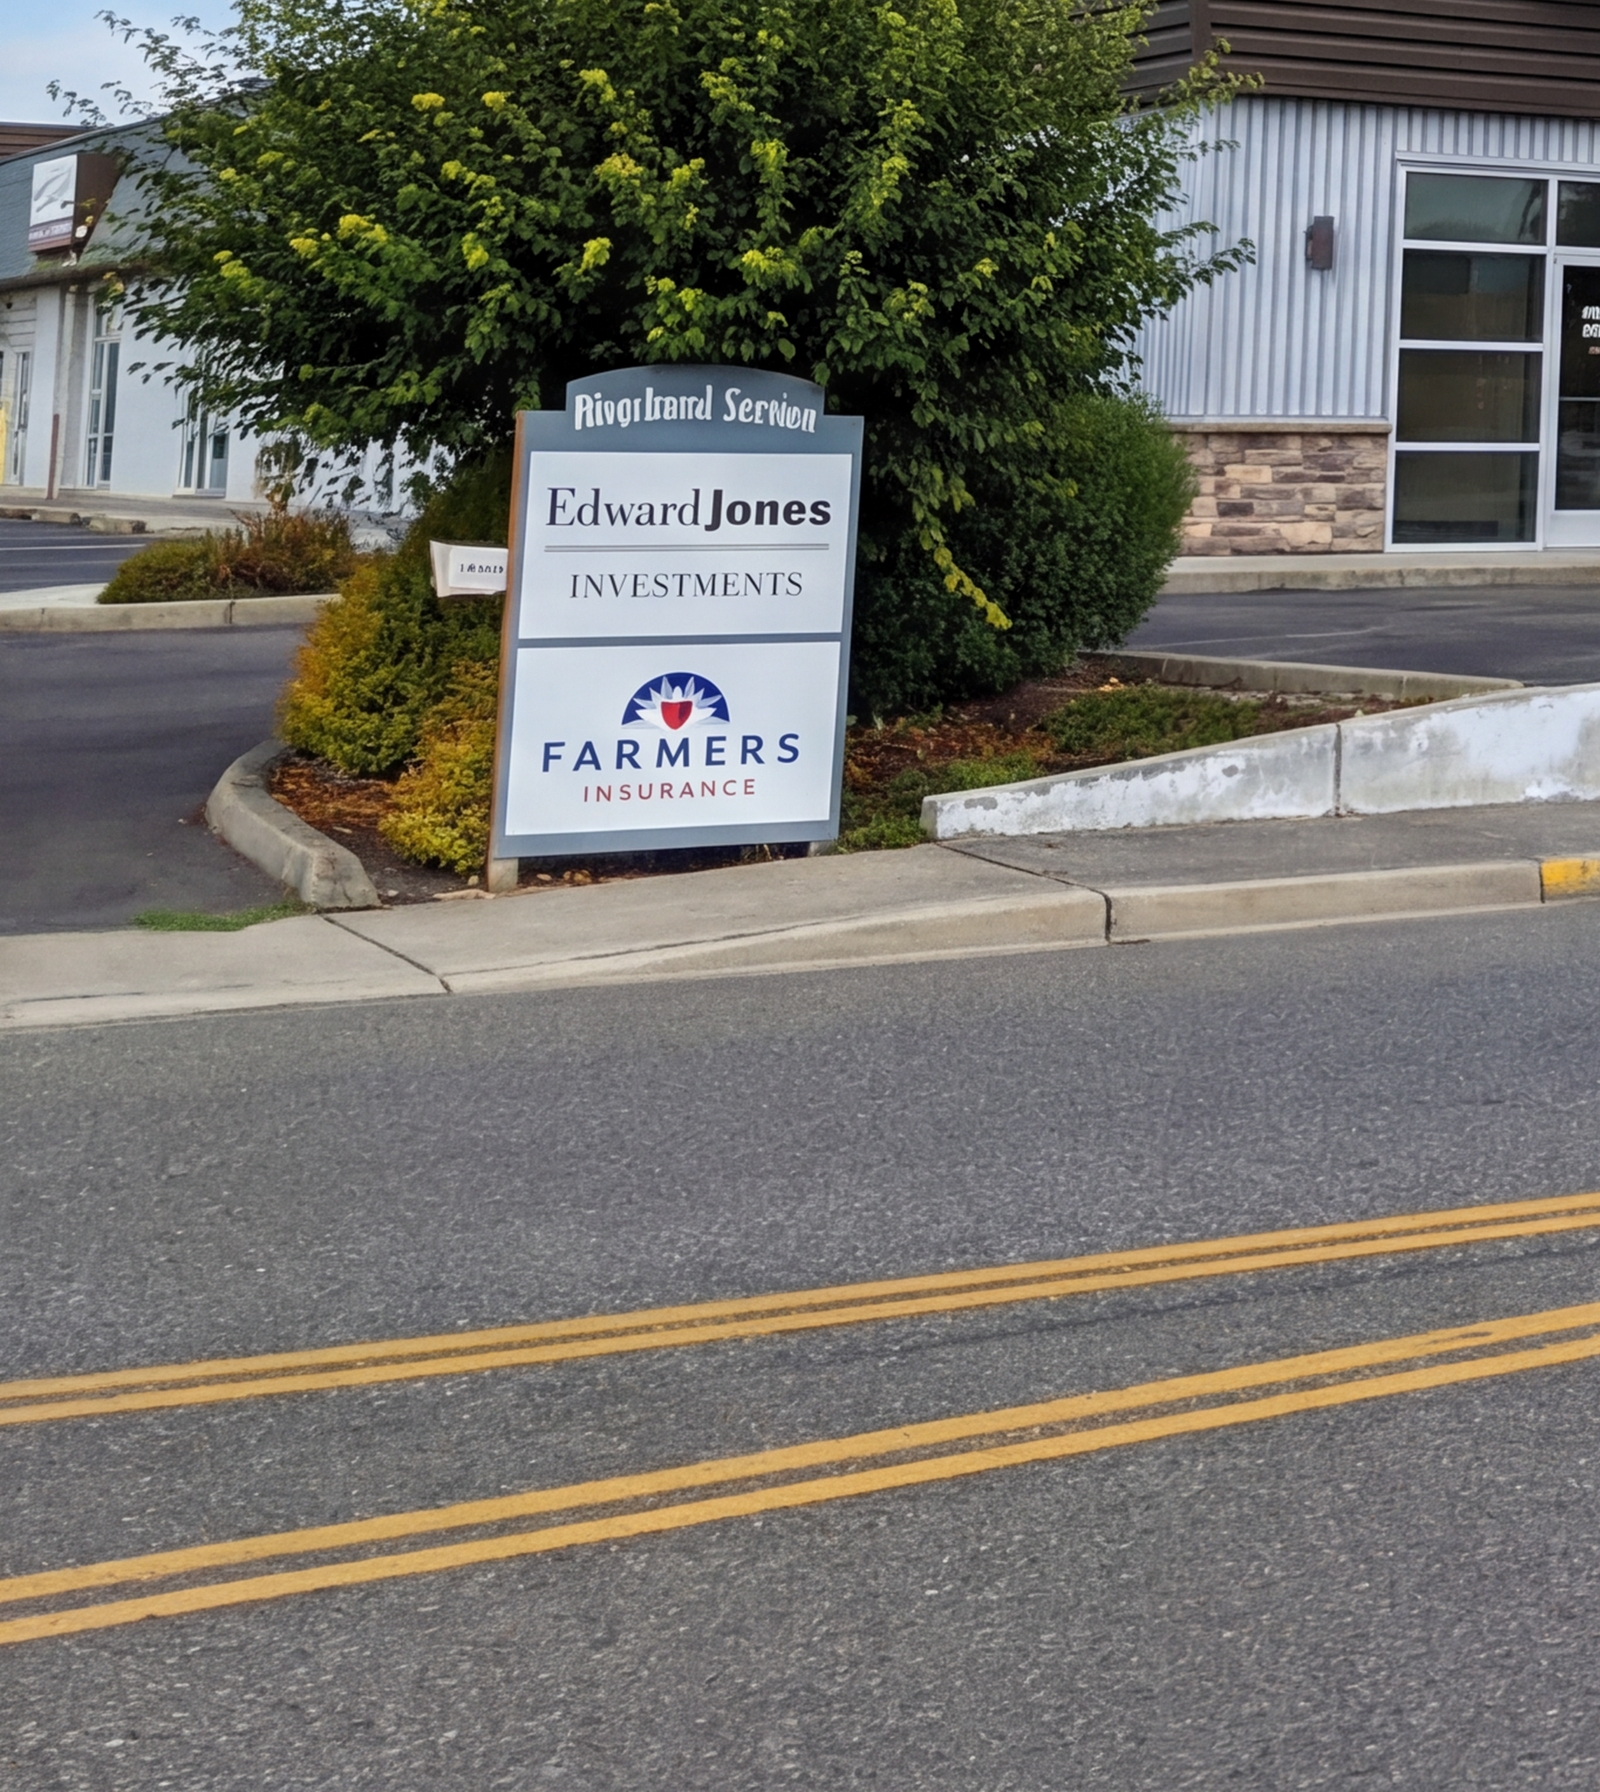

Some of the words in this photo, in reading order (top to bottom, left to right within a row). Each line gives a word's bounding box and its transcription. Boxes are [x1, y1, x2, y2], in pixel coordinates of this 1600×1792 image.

[570, 572, 803, 599] INVESTMENTS
[542, 733, 800, 773] FARMERS
[584, 778, 756, 804] INSURANCE
